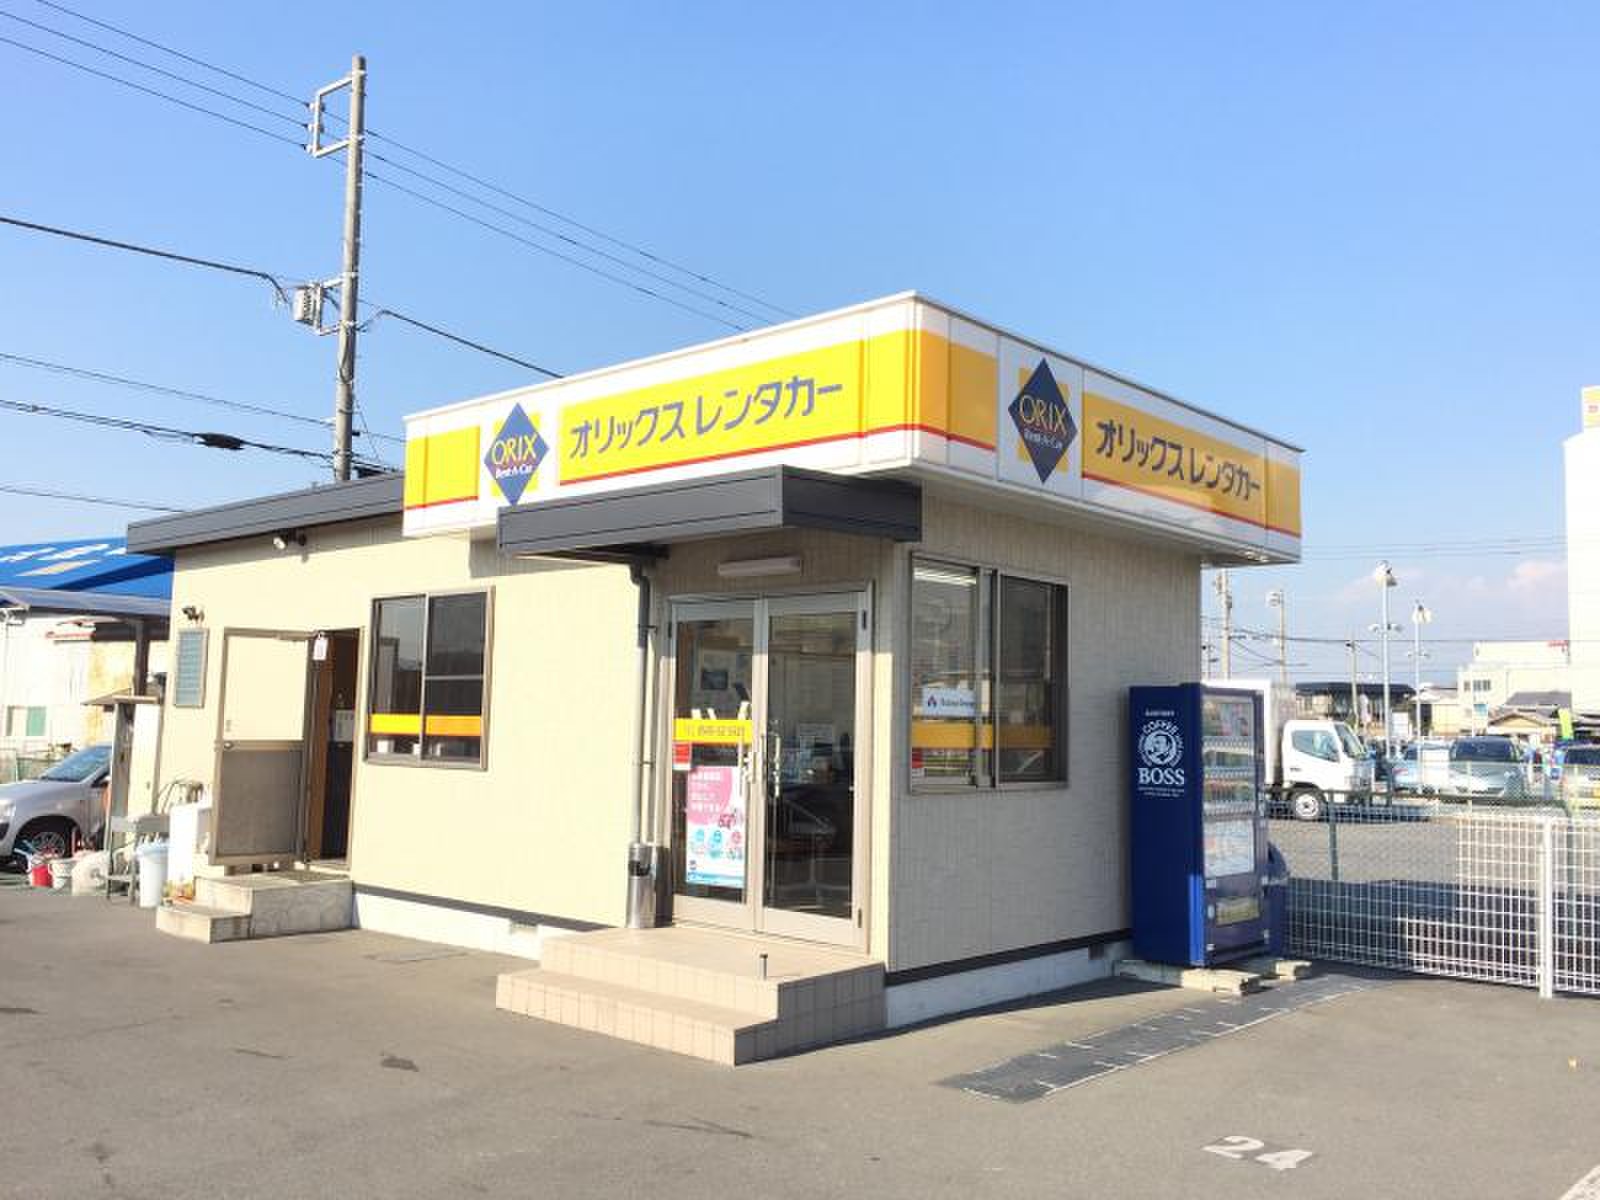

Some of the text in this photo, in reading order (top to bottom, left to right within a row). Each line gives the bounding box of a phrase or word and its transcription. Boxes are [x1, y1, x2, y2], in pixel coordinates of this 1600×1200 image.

[1020, 395, 1068, 438] ORIX
[491, 432, 538, 464] ORIX
[1137, 767, 1185, 785] BOSS
[1201, 1136, 1313, 1171] 24
